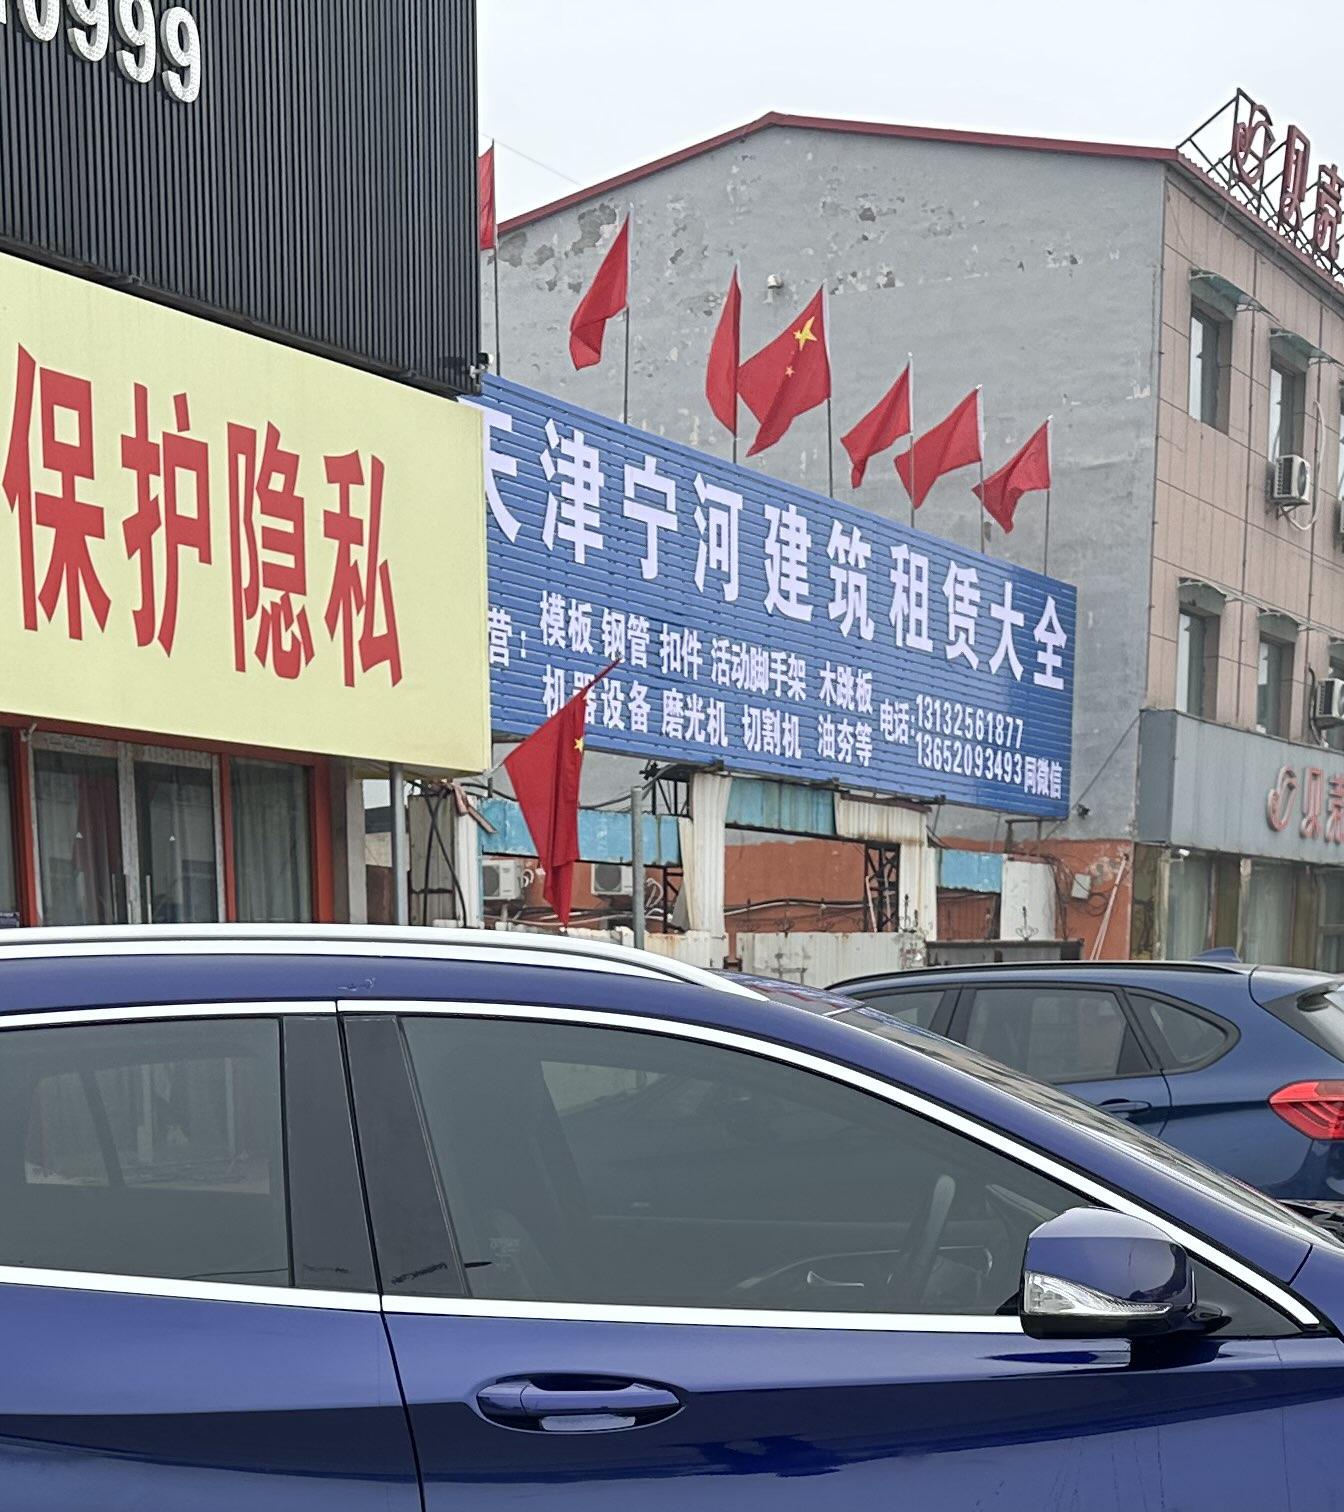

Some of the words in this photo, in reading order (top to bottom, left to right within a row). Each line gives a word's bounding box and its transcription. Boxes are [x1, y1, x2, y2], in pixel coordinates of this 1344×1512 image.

[2, 343, 404, 689] 保护隐私
[540, 590, 594, 654] 模板
[601, 607, 651, 668] 钢管
[660, 622, 703, 680] 扣件
[711, 637, 806, 701] 活动脚手架
[819, 660, 873, 714] 木跳板
[542, 664, 652, 734] 机器设备
[661, 687, 728, 747] 磨光机
[742, 704, 802, 759] 切割机
[817, 714, 873, 767] 油夯等
[916, 694, 1024, 749] 13132561877
[916, 731, 1023, 785] 13652093493
[1024, 755, 1063, 800] 同微信
